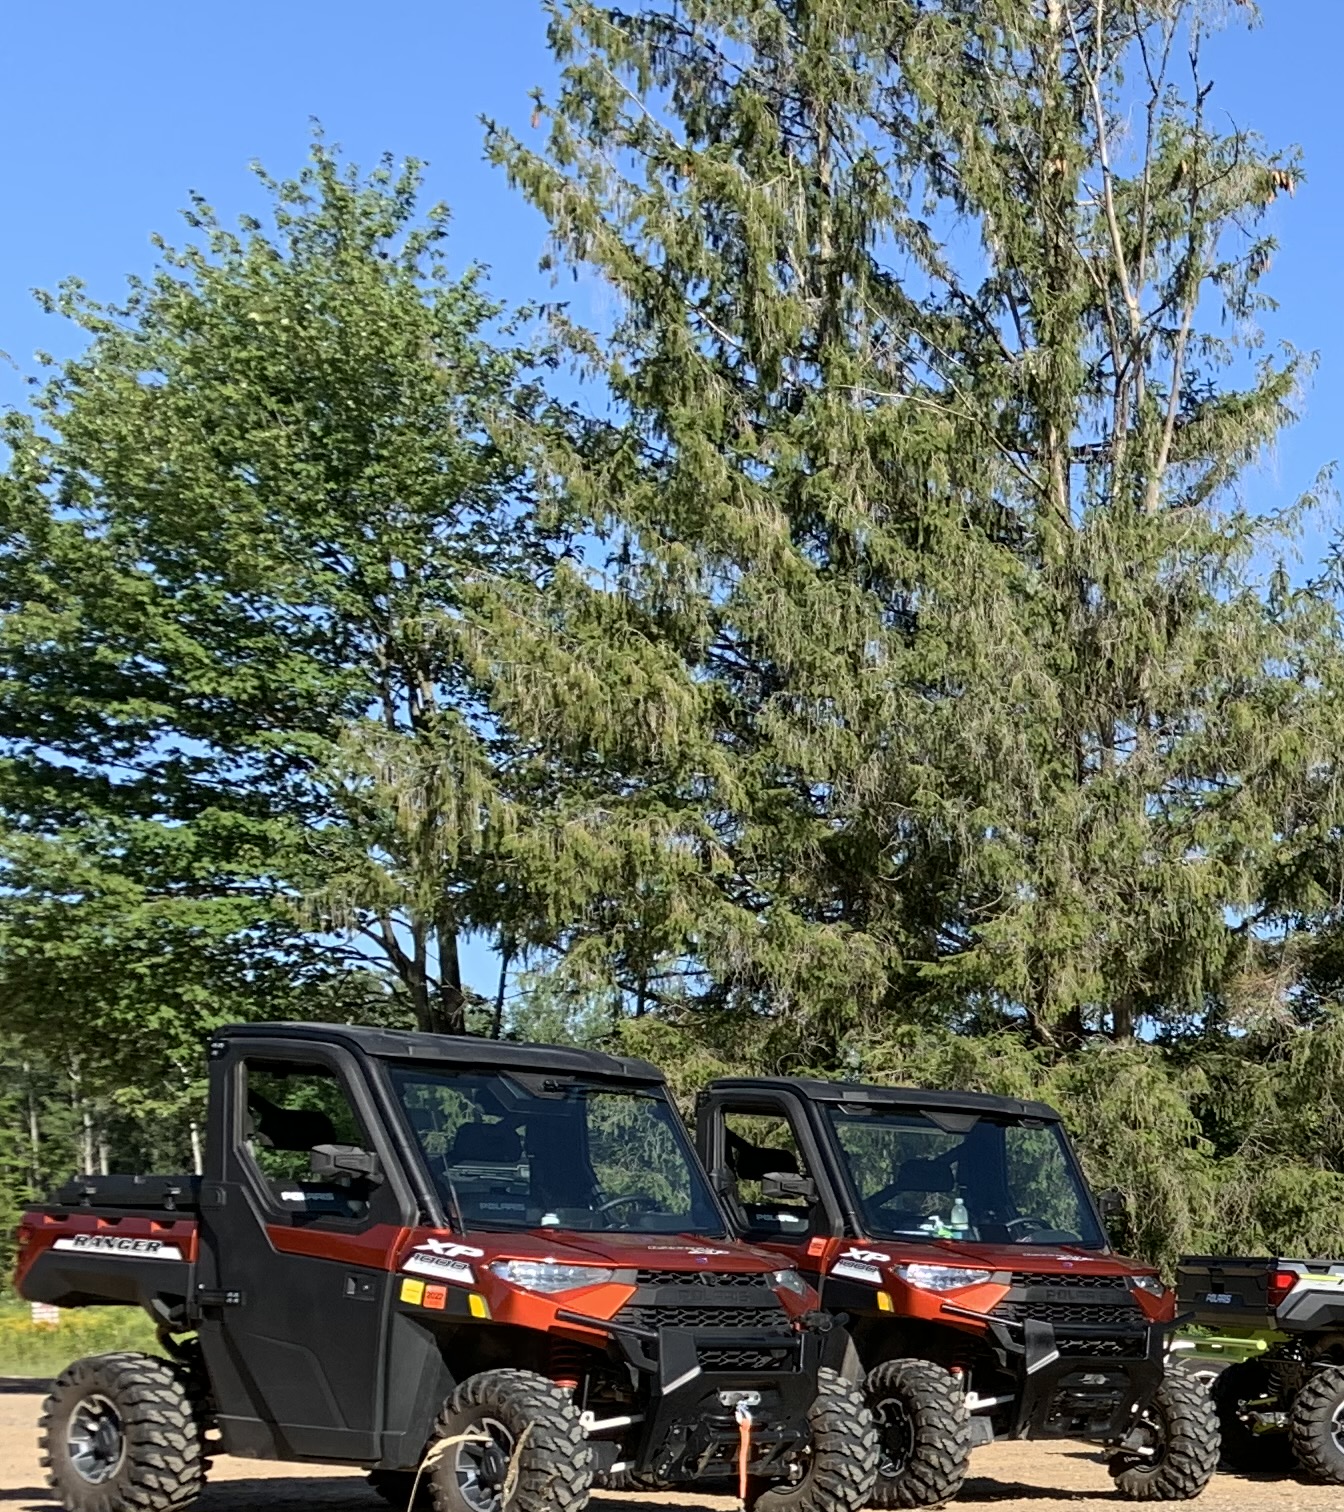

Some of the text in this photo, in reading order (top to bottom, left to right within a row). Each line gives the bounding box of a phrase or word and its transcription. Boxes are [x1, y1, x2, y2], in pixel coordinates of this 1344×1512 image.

[73, 1234, 164, 1252] RANGER
[413, 1239, 484, 1258] XP
[414, 1253, 470, 1270] 1000
[839, 1247, 891, 1262] XP
